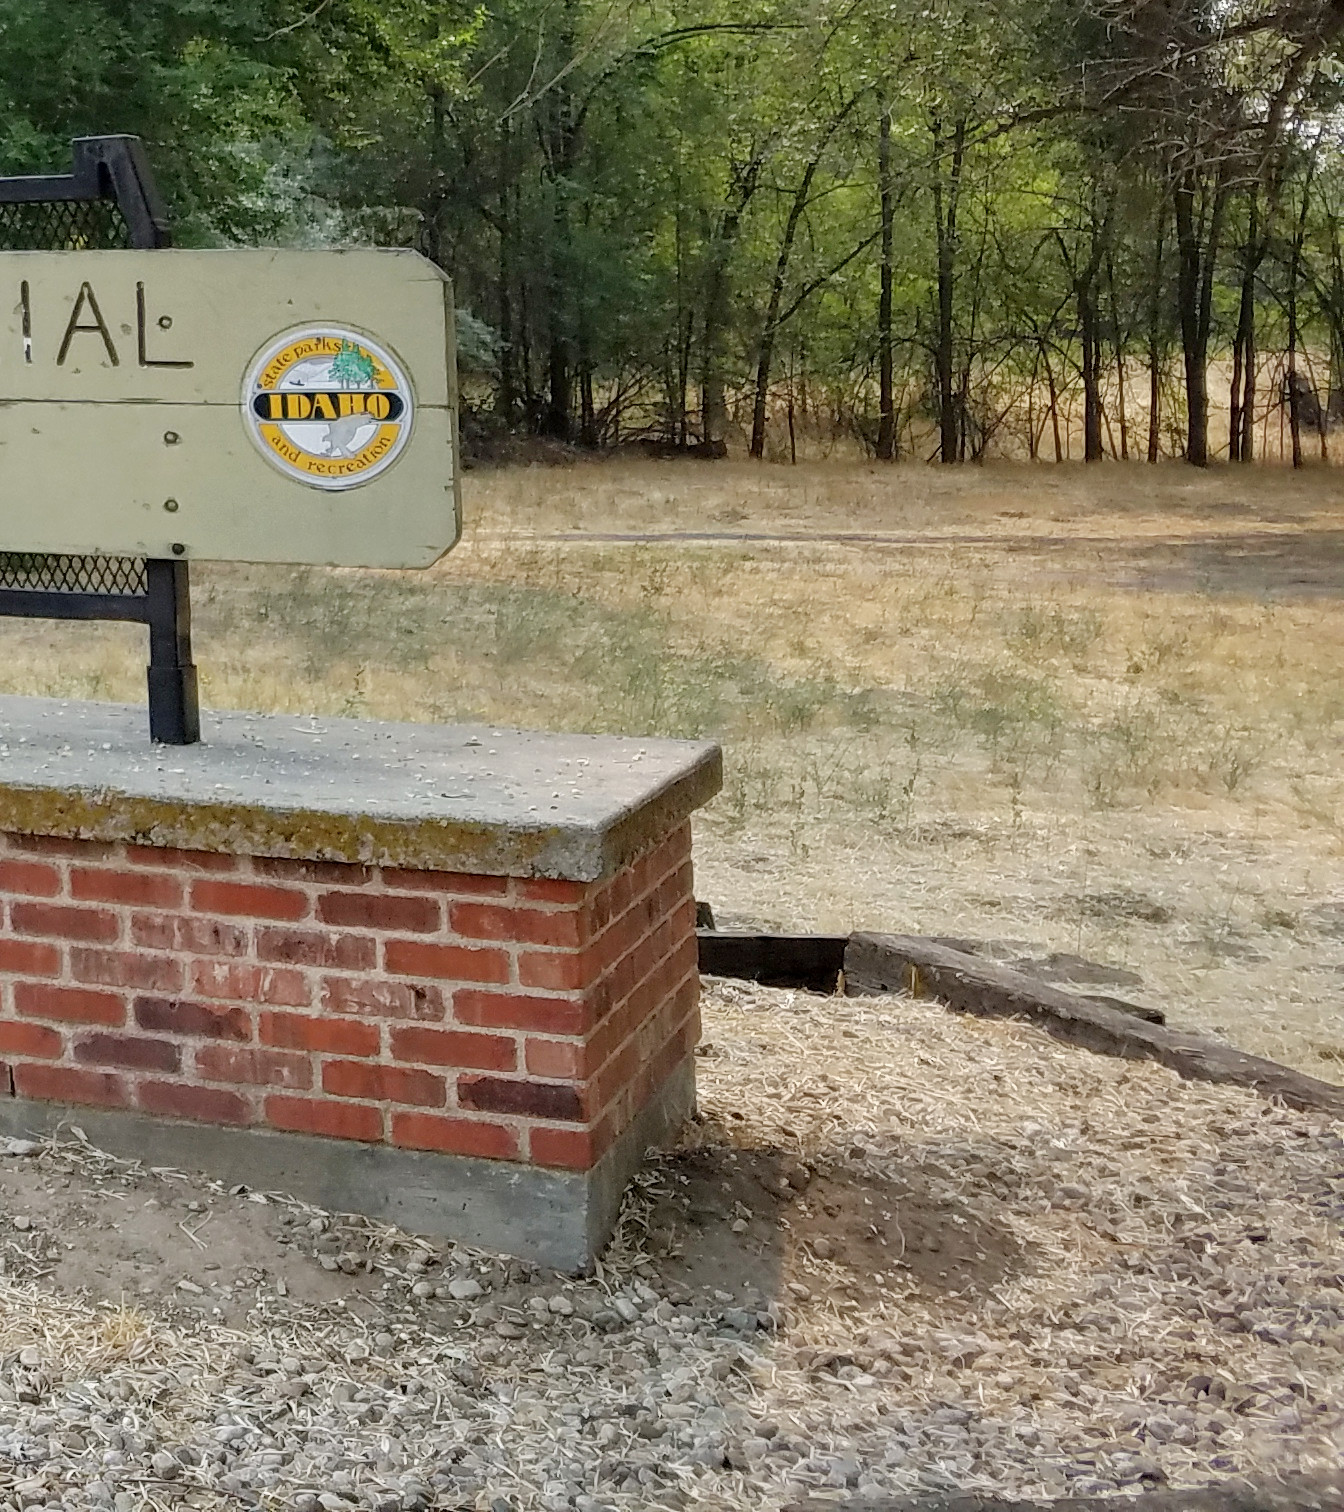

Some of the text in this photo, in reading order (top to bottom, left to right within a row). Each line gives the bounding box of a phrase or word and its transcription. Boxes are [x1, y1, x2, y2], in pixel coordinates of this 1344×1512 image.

[263, 337, 343, 388] state parks
[268, 393, 391, 420] IDAHO
[271, 435, 391, 475] and recreation
